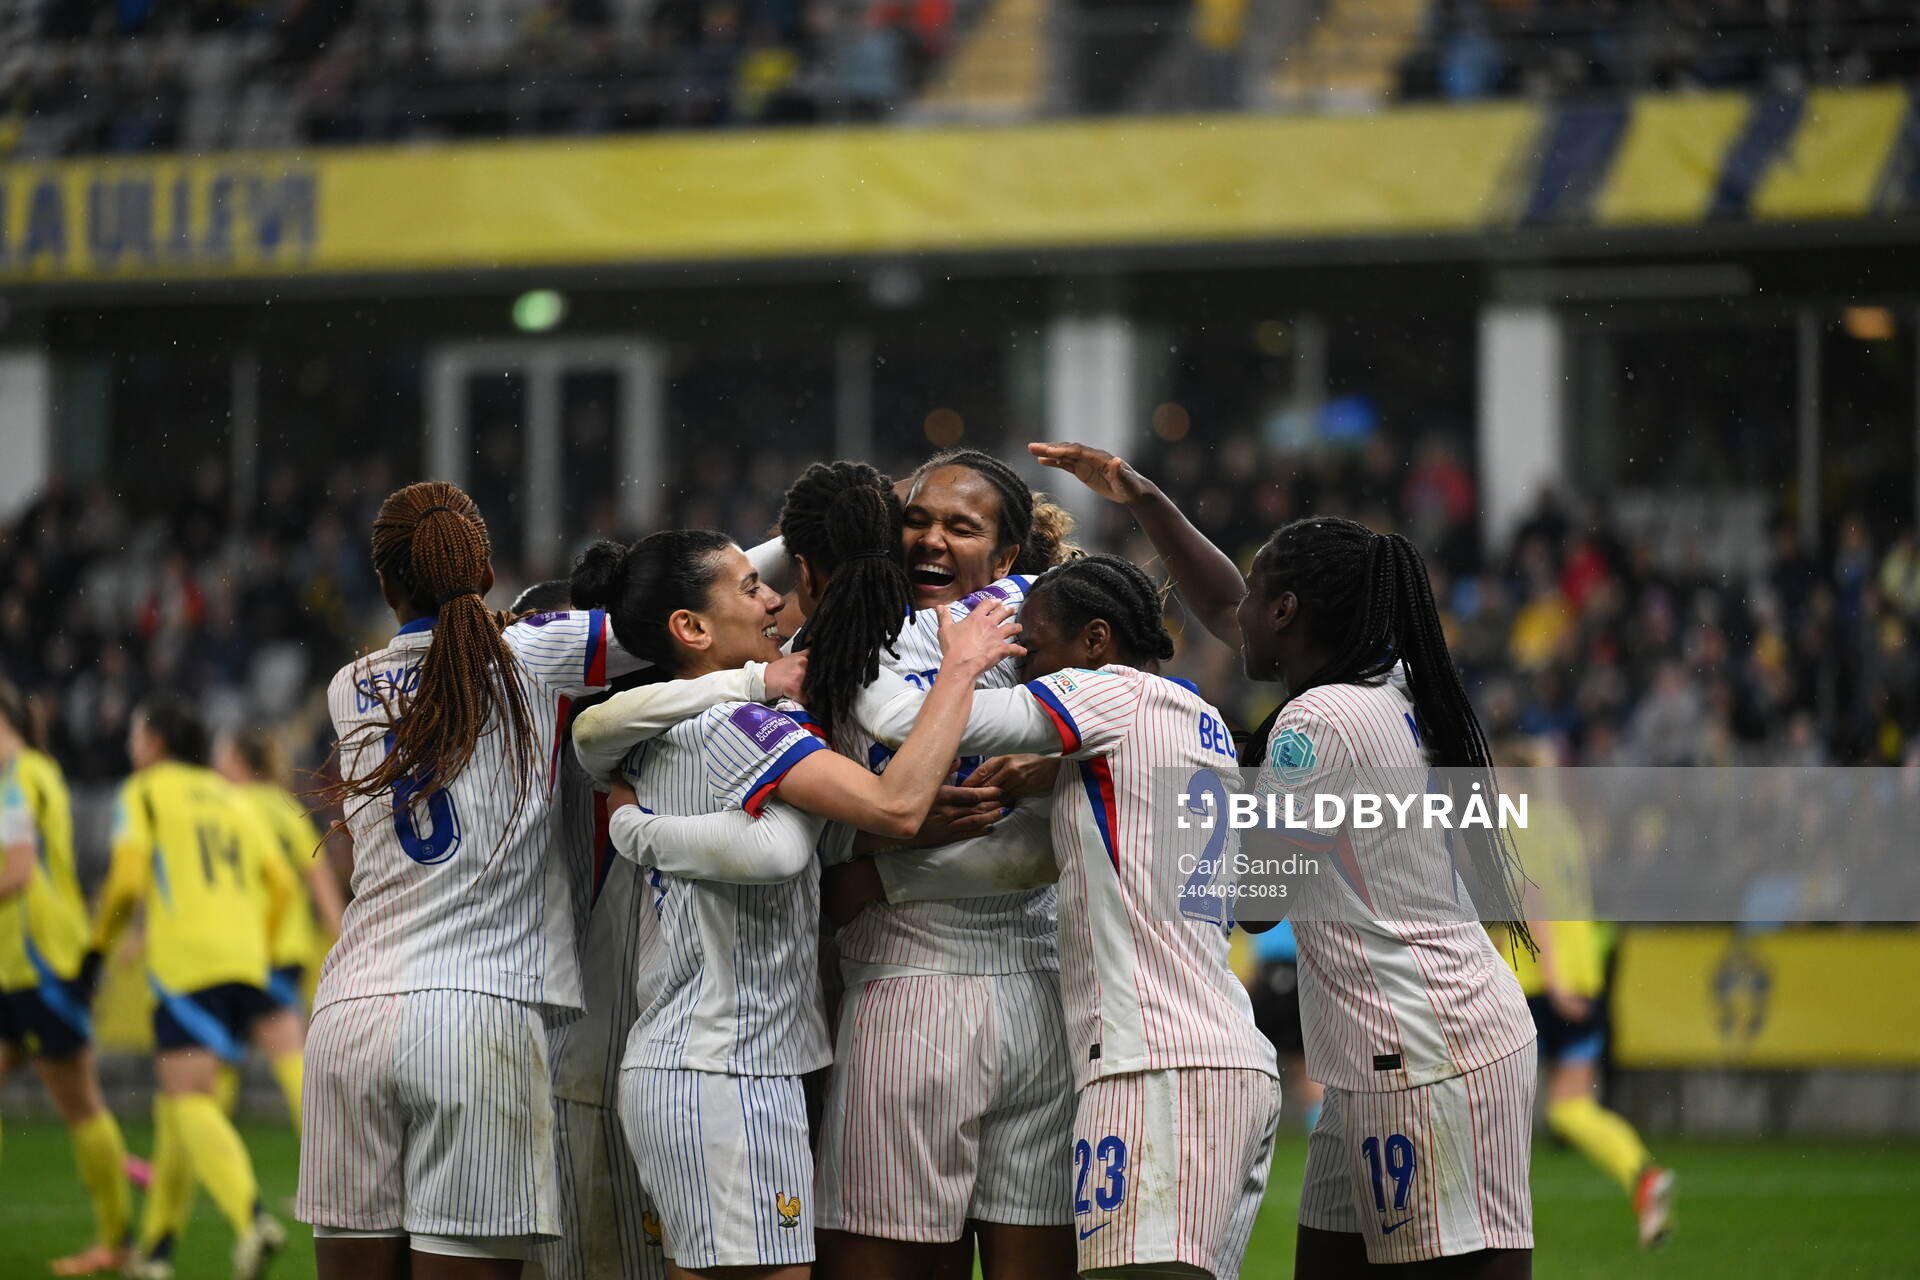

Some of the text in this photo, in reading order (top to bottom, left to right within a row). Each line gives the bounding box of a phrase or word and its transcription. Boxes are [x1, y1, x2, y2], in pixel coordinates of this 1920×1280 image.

[755, 716, 787, 738] EUROPEAN
[194, 820, 247, 891] 14
[1179, 768, 1235, 931] 2
[1074, 1135, 1127, 1216] 23
[1361, 1133, 1418, 1211] 19
